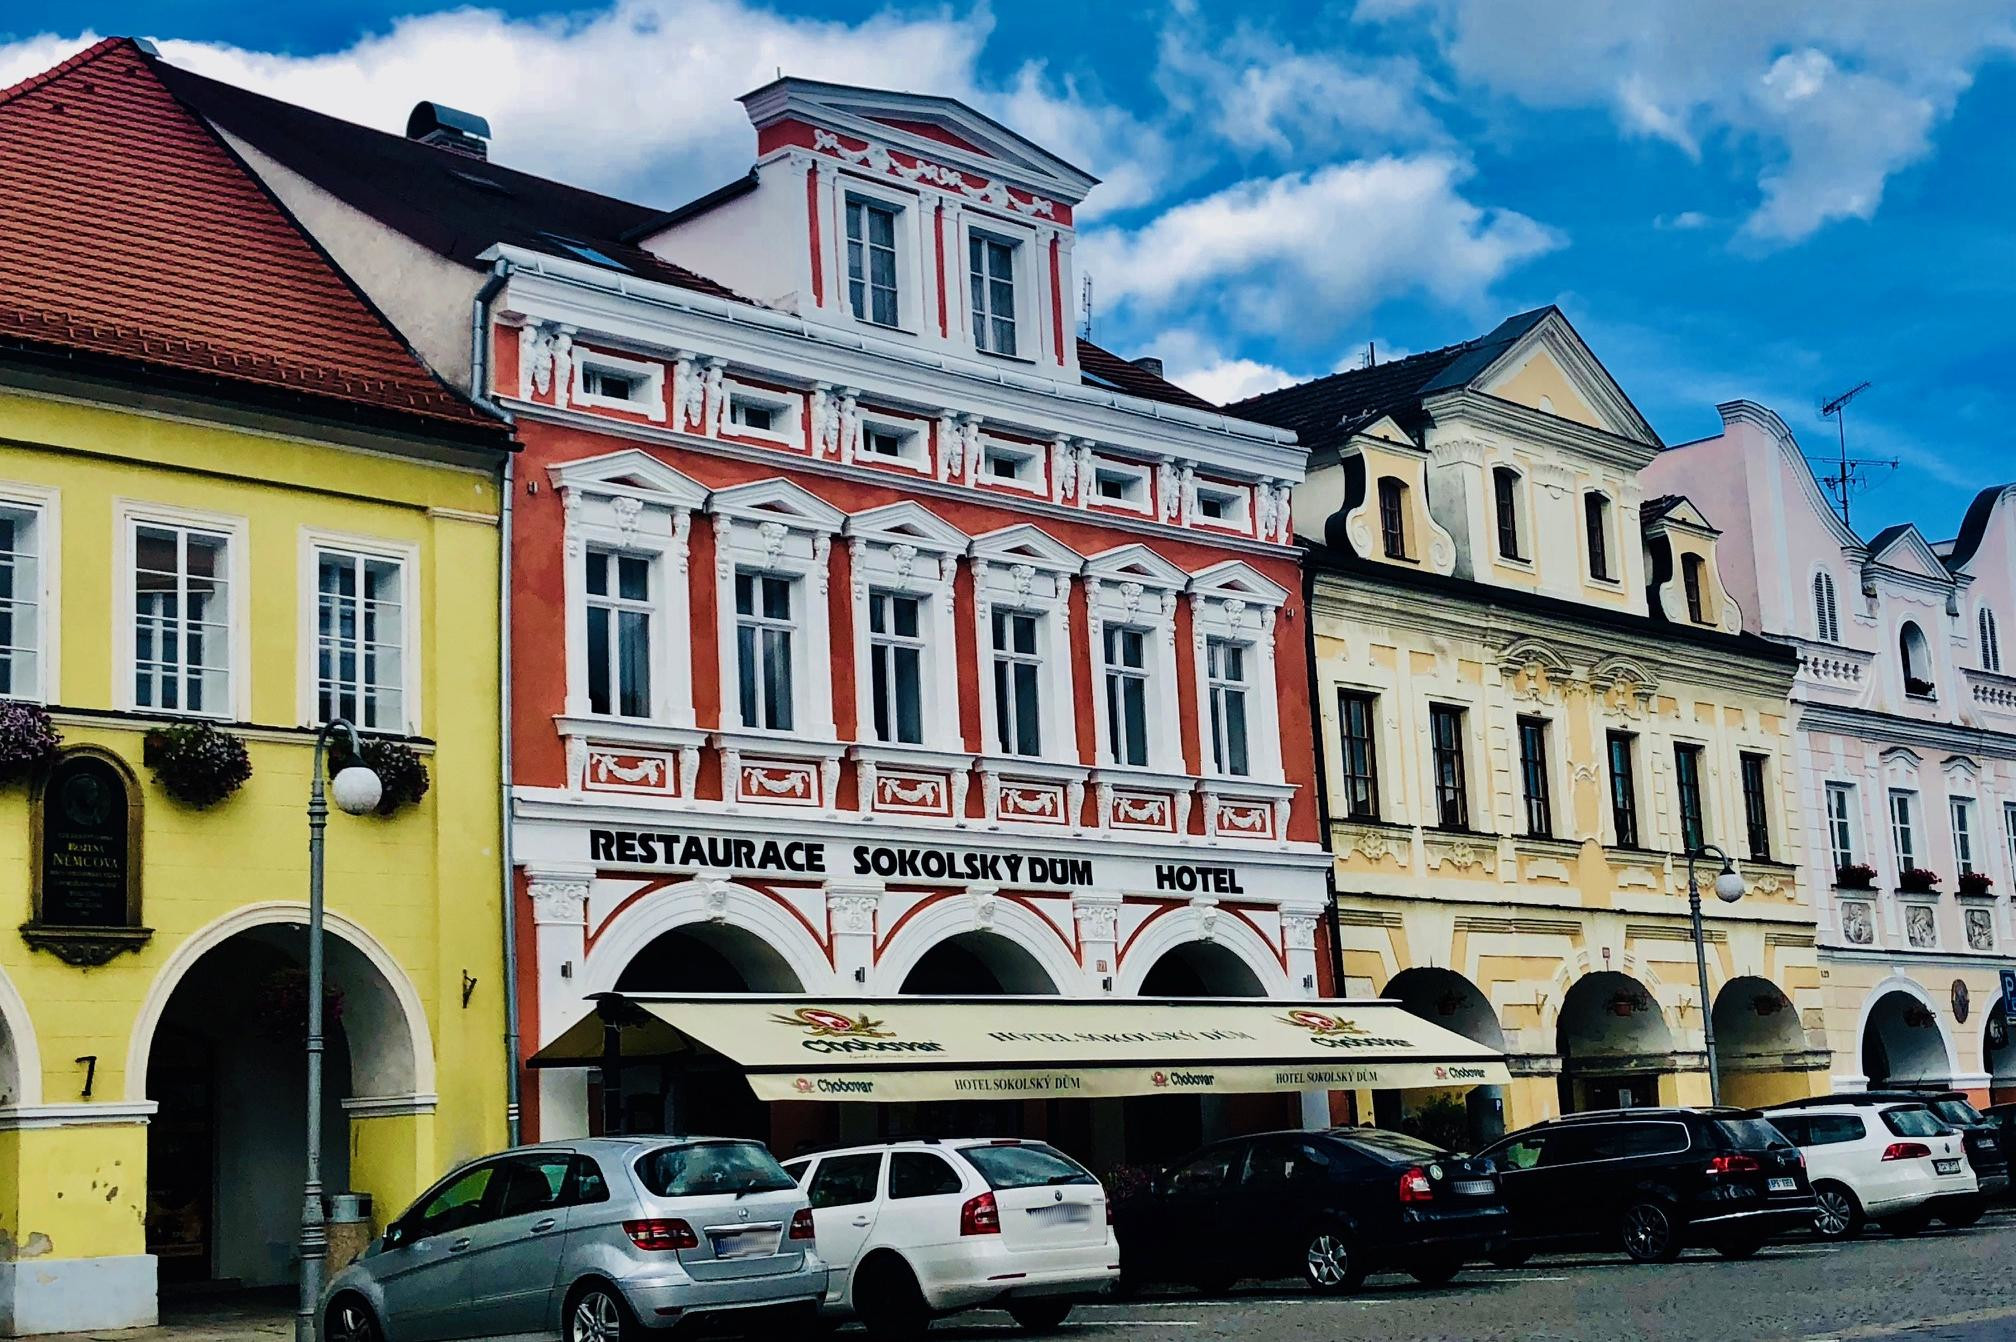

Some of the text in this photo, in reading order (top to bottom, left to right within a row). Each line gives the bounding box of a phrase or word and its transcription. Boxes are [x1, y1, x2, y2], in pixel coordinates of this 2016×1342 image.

[590, 829, 826, 873] RESTAURACE
[1155, 864, 1244, 895] HOTEL
[987, 1032, 1072, 1042] HOTEL
[1276, 1072, 1305, 1084] HOTEL
[954, 1079, 992, 1091] HOTEL
